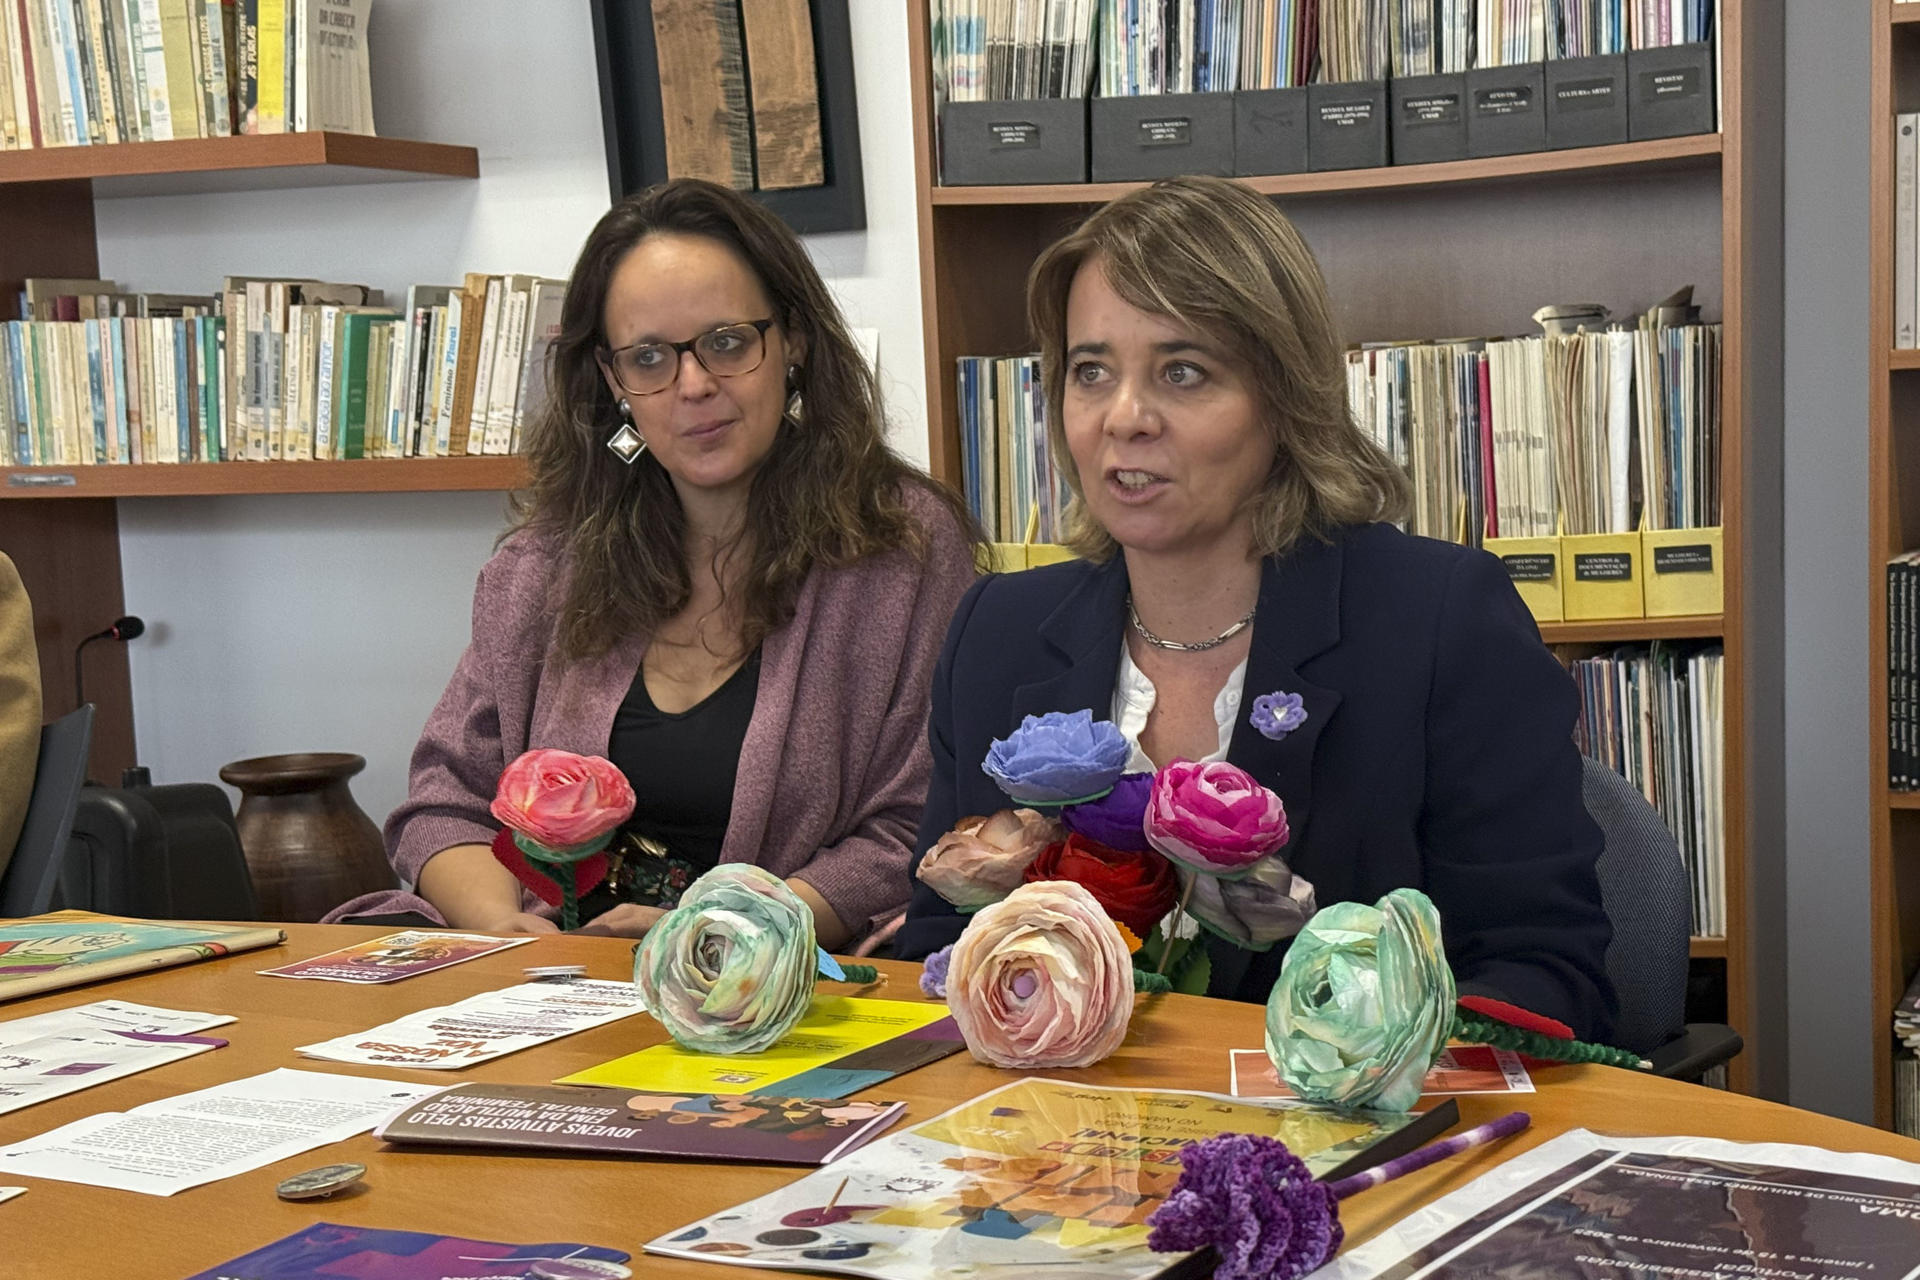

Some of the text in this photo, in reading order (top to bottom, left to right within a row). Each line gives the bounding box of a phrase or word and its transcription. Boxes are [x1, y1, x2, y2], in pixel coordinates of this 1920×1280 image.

[320, 341, 332, 379] amor
[440, 326, 457, 418] Feminino Plural
[427, 1024, 492, 1034] ouvida
[436, 1031, 510, 1041] precisa
[368, 1055, 439, 1063] porque
[463, 1050, 499, 1058] A
[440, 1095, 618, 1115] GENITAL FEMININA
[423, 1102, 608, 1124] FIM DA MUTILAÇÃO
[408, 1112, 642, 1138] JOVENS ATIVISTAS PELO
[1617, 1169, 1722, 1187] ASSASSINADAS
[1723, 1182, 1802, 1196] MULHERES
[1803, 1191, 1825, 1199] DE
[1573, 1228, 1613, 1239] 2025
[1642, 1238, 1728, 1253] novembro
[1575, 1255, 1733, 1280] Assassinadas
[1800, 1256, 1866, 1268] janeiro
[1713, 1263, 1814, 1280] Portugal
